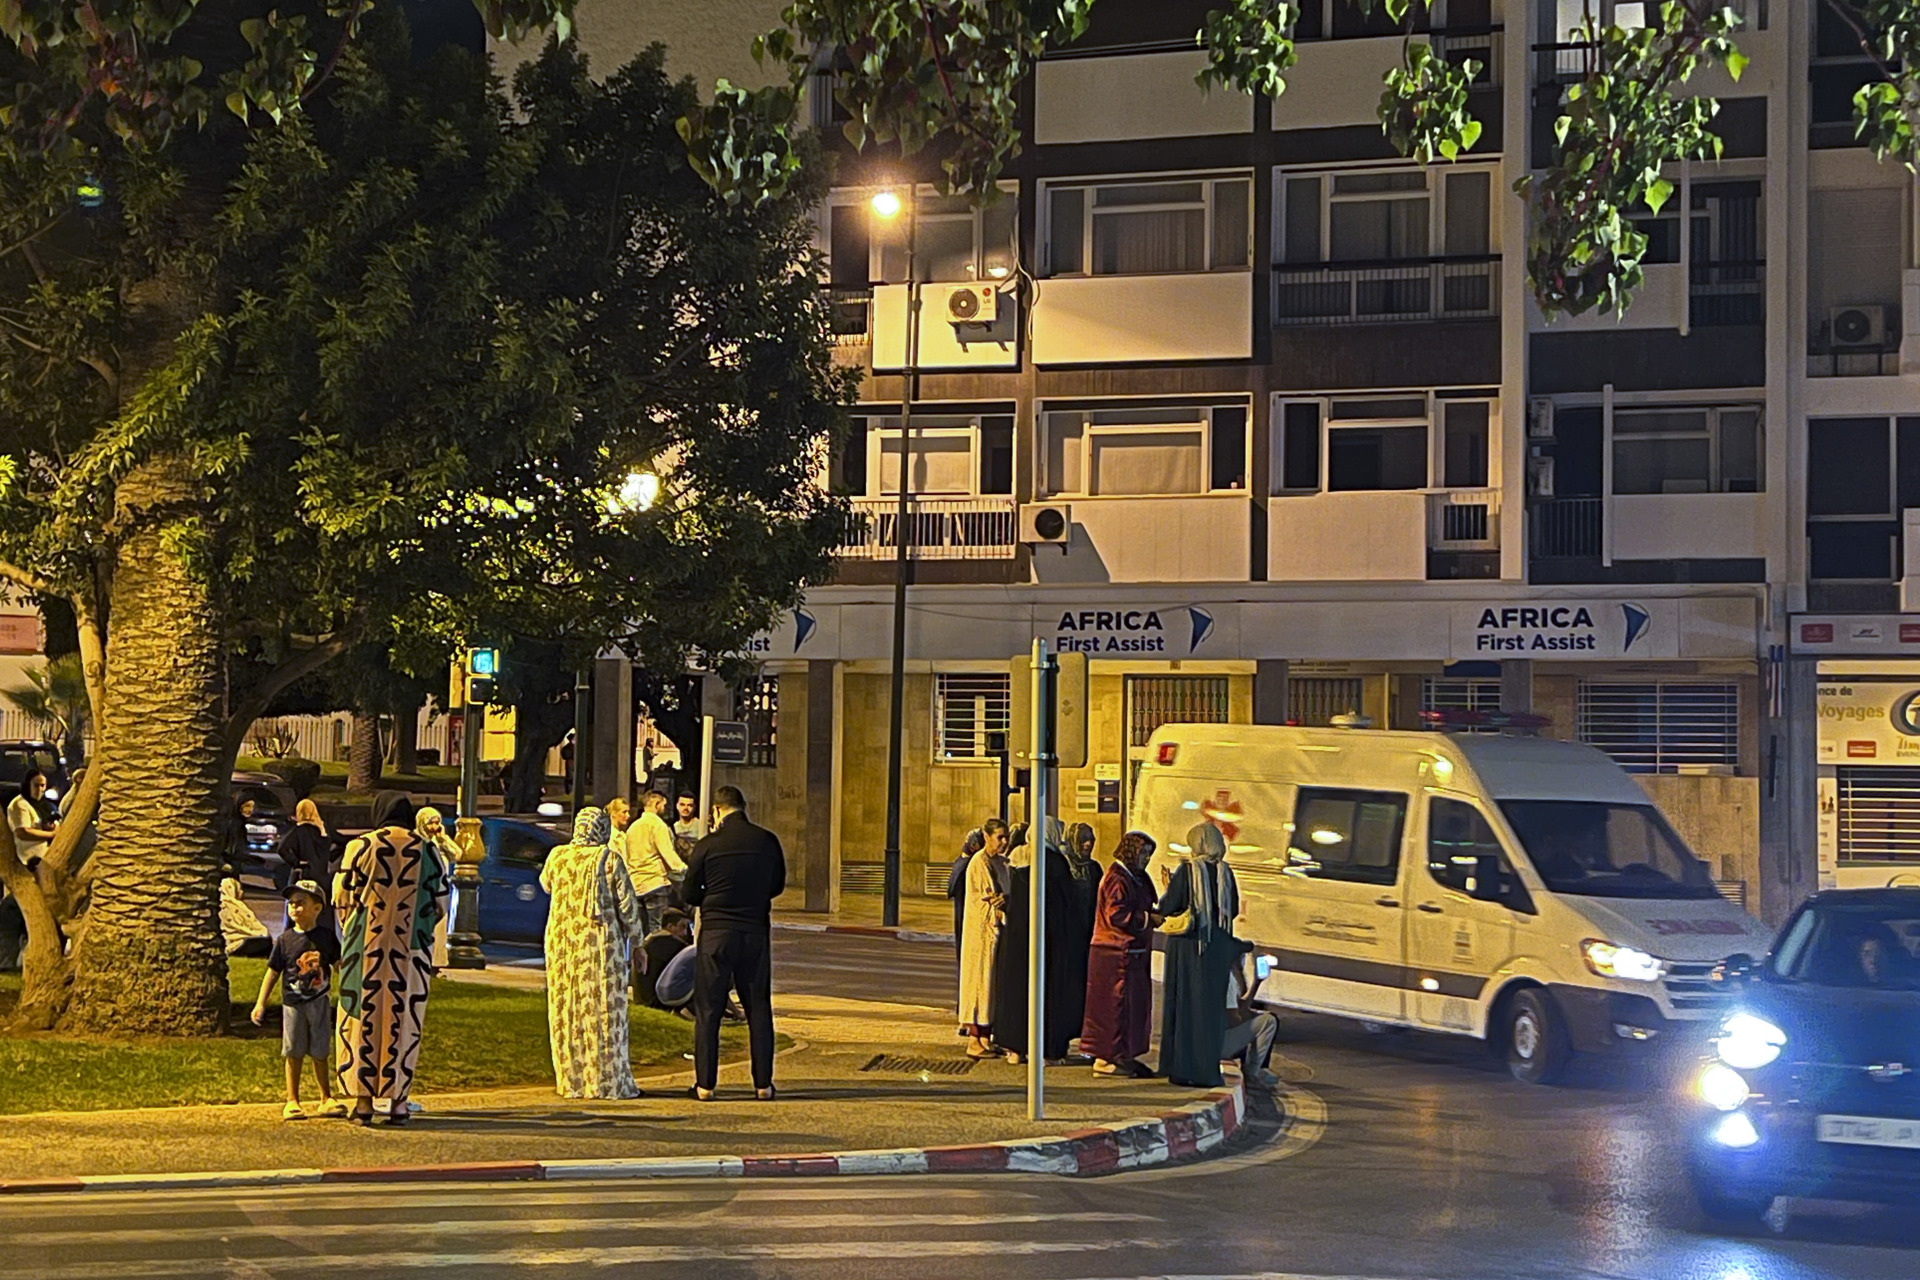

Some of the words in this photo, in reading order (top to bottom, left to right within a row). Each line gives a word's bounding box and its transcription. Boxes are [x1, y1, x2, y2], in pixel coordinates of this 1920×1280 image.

[1057, 611, 1163, 631] AFRICA
[1477, 608, 1594, 628] AFRICA
[1056, 636, 1100, 651] First
[1105, 635, 1164, 651] Assist
[1477, 634, 1524, 650] First
[1531, 634, 1595, 650] Assist
[1816, 687, 1836, 696] nce
[1839, 685, 1852, 696] de
[1817, 704, 1885, 720] Voyages
